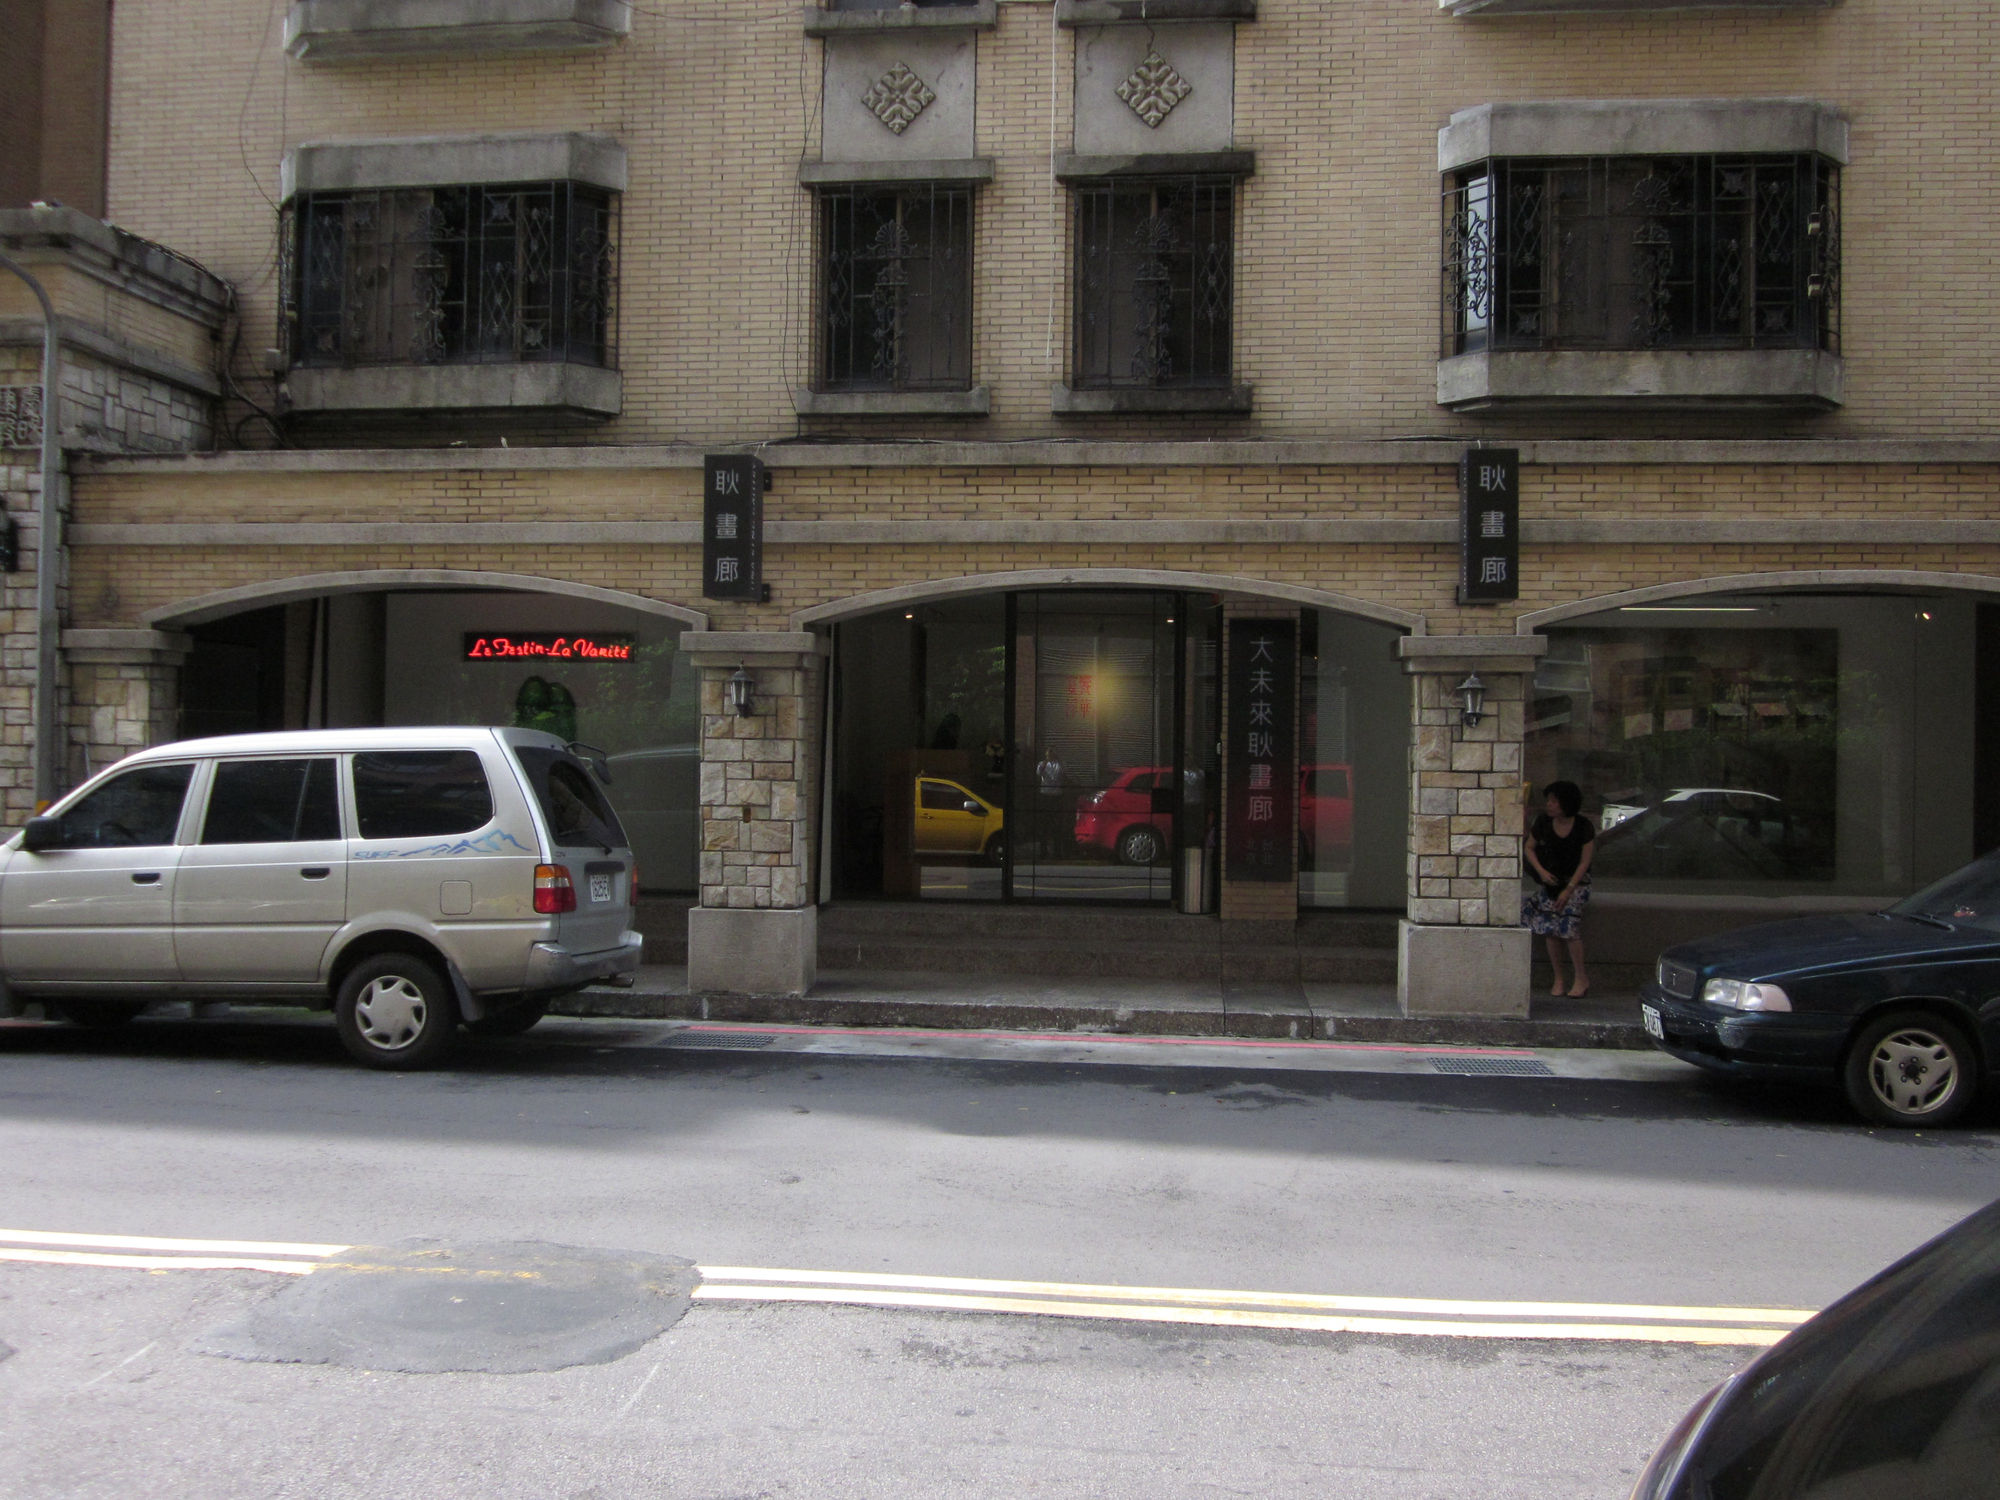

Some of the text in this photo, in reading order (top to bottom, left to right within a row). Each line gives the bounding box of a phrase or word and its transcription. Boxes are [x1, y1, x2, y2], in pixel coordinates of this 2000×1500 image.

[714, 467, 740, 583] 耿畫廊
[1479, 464, 1507, 583] 耿畫廊
[468, 638, 492, 657] Le
[1247, 636, 1274, 823] 大未來耿畫廊
